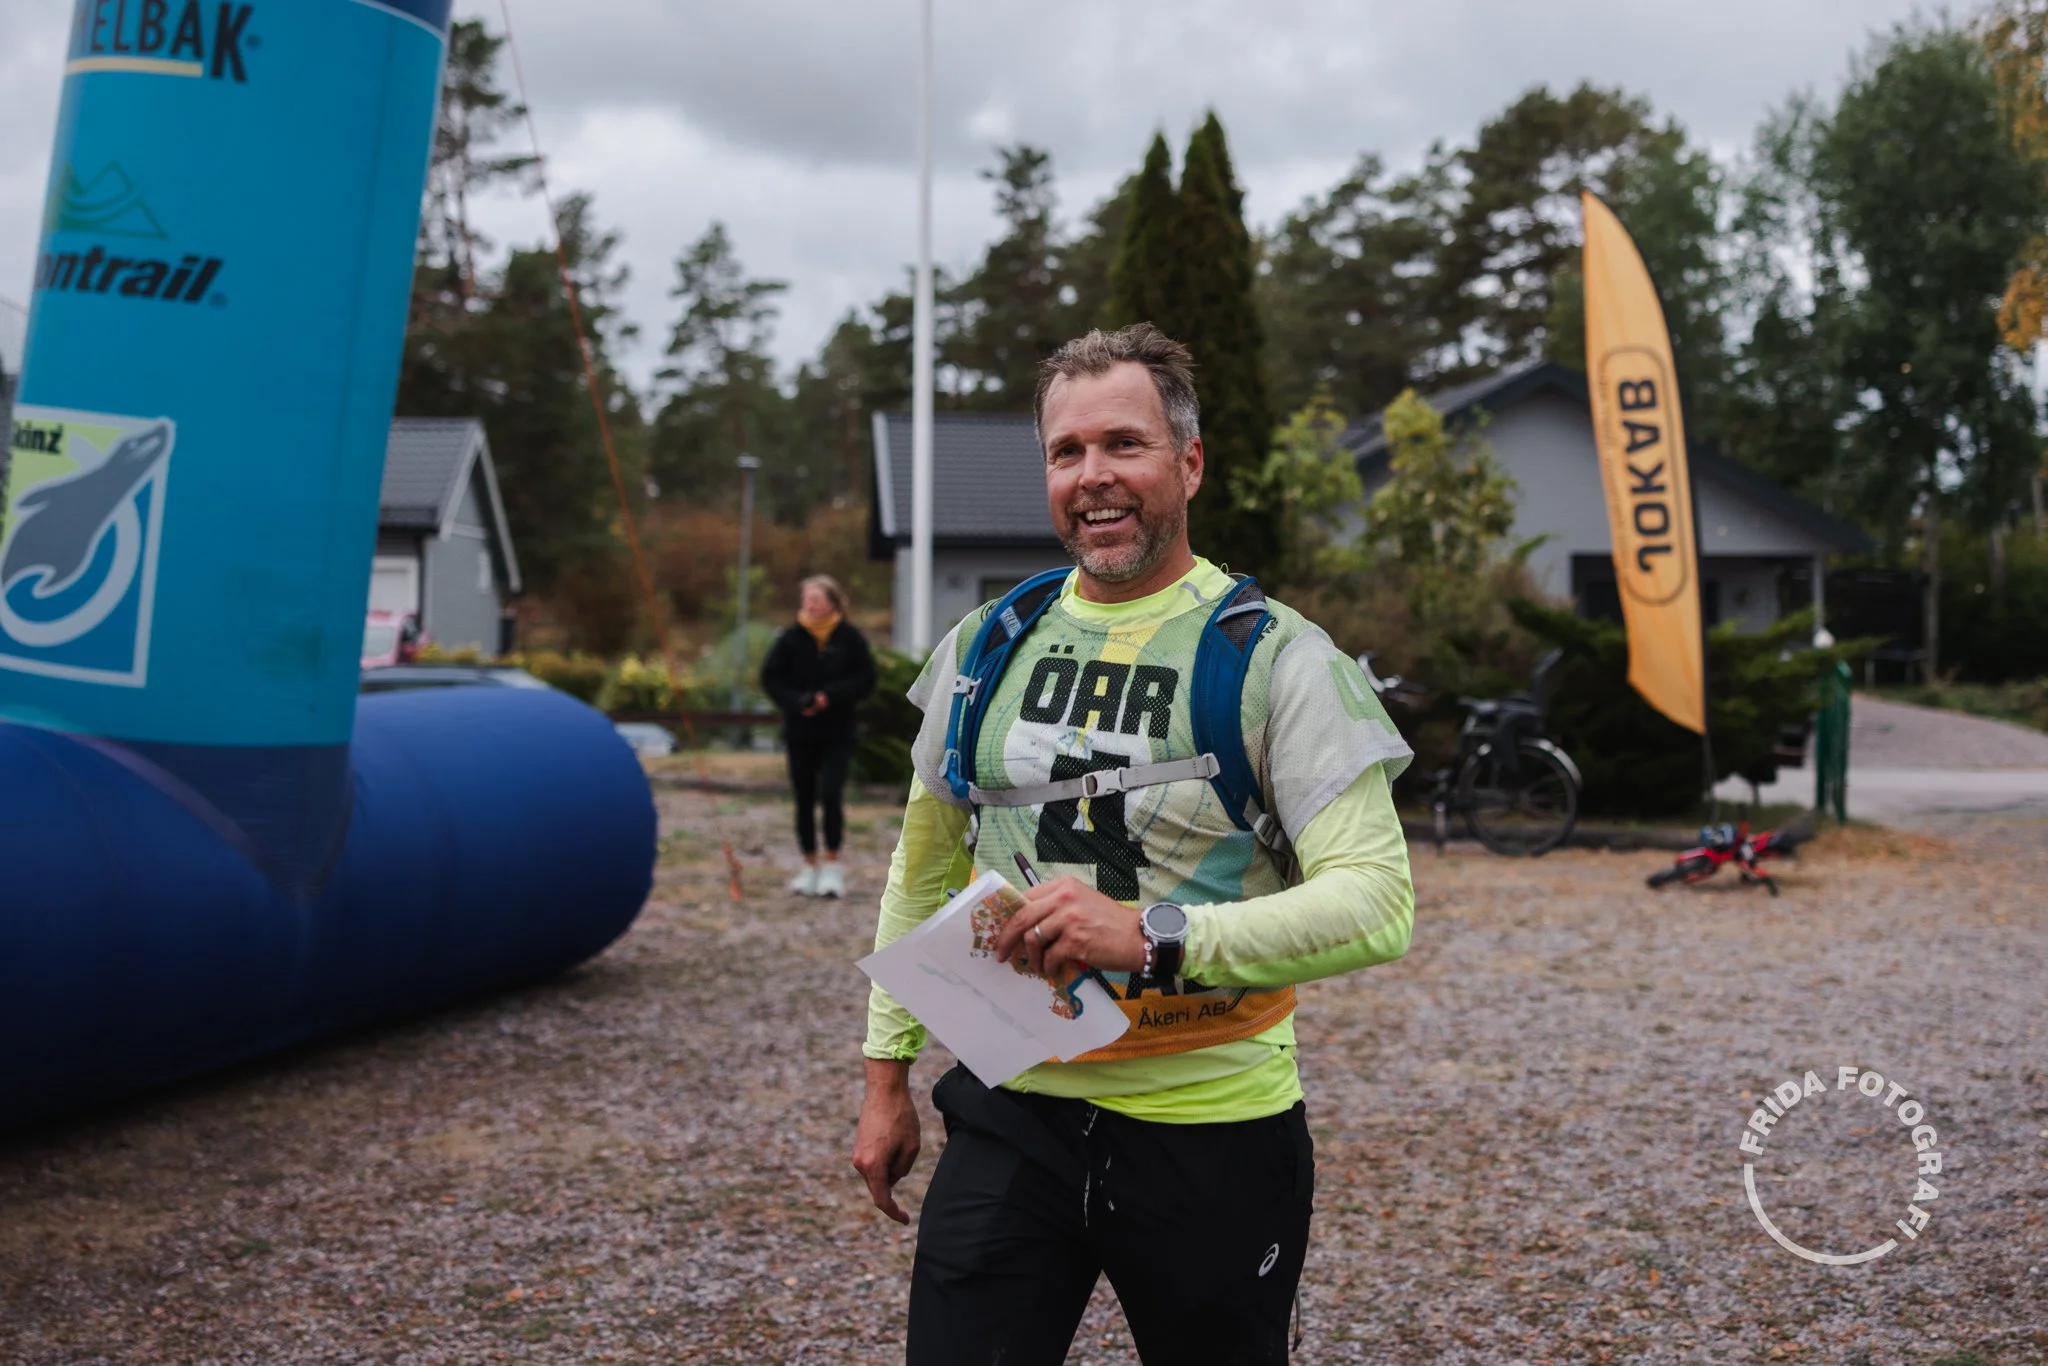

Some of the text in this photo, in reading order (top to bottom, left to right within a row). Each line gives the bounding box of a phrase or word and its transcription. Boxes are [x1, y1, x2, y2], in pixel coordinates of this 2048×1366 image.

[1020, 644, 1180, 740] ÖAR
[1138, 1001, 1226, 1029] Åkeri AB
